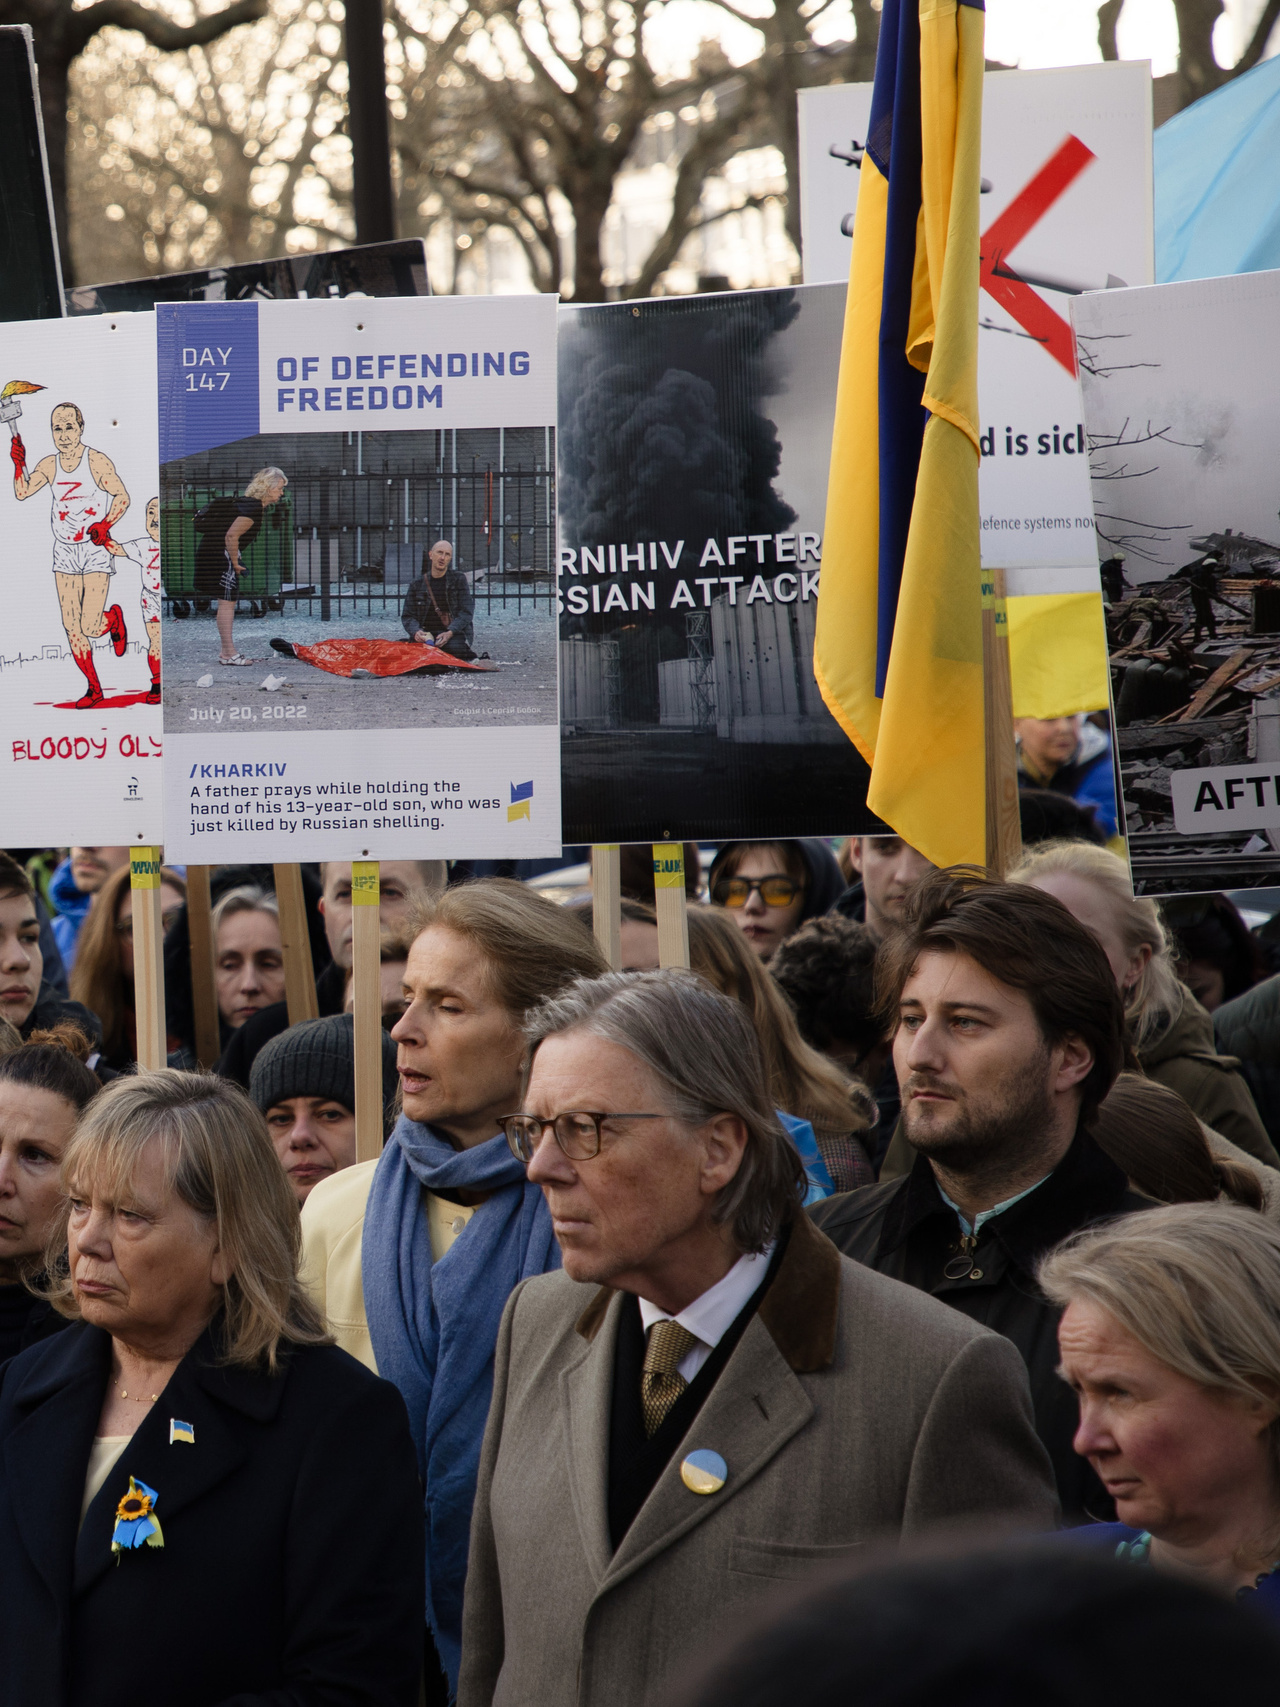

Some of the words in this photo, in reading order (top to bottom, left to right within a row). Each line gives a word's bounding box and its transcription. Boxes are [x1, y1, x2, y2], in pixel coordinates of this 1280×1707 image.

[182, 347, 232, 367] DAY
[276, 356, 320, 381] OF
[331, 350, 530, 380] DEFENDING
[184, 372, 231, 392] 147
[277, 384, 443, 412] FREEDOM
[1006, 426, 1029, 456] is
[1024, 516, 1071, 533] systems
[699, 531, 821, 568] AFTER
[670, 571, 820, 609] ATTACK
[188, 706, 225, 723] July
[229, 706, 257, 722] 20,
[262, 705, 307, 719] 2022
[12, 736, 107, 762] BLOODY
[189, 763, 287, 778] /KHARKIV
[190, 786, 201, 797] A
[205, 785, 259, 797] father
[264, 785, 312, 799] prays
[316, 781, 361, 795] while
[366, 780, 429, 796] holding
[433, 780, 461, 793] the
[190, 802, 229, 815] hand
[234, 801, 251, 814] of
[256, 800, 282, 814] his
[393, 799, 426, 813] son,
[431, 797, 463, 810] who
[468, 798, 501, 810] was
[190, 819, 223, 835] just
[227, 818, 274, 832] killed
[279, 818, 298, 834] by
[302, 816, 368, 831] Russian
[373, 815, 445, 831] shelling.
